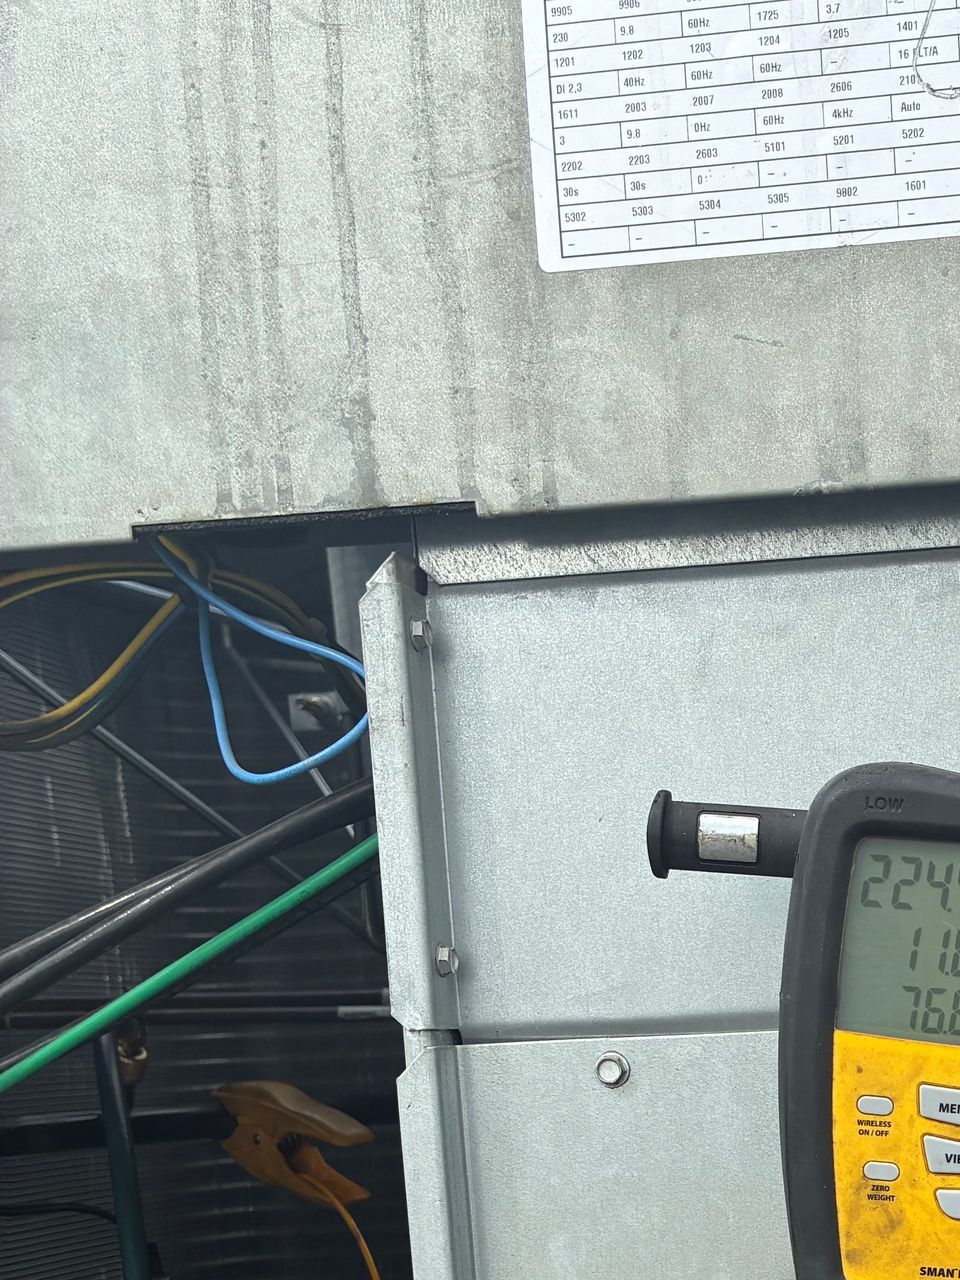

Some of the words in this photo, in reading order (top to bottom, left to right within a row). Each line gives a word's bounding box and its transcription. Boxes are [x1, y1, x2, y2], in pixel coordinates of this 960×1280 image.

[551, 6, 573, 17] 9905
[552, 33, 569, 43] 230
[620, 25, 634, 36] 9.8
[688, 18, 710, 29] 60Hz
[758, 10, 779, 21] 1725
[826, 4, 840, 14] 3.7
[554, 57, 575, 68] 1201
[622, 50, 643, 61] 1202
[690, 43, 712, 54] 1203
[759, 36, 780, 46] 1204
[828, 28, 850, 39] 1205
[897, 21, 918, 32] 1401
[624, 77, 645, 88] 40Hz
[691, 70, 712, 81] 60Hz
[760, 62, 782, 73] 60Hz
[558, 109, 578, 120] 1611
[625, 102, 647, 114] 2003
[693, 95, 714, 106] 2007
[762, 88, 784, 99] 2008
[830, 81, 852, 92] 2606
[763, 115, 784, 126] 60Hz
[832, 108, 854, 119] 4kHz
[901, 102, 921, 112] Auto
[562, 161, 583, 172] 2202
[628, 154, 650, 166] 2203
[696, 148, 718, 160] 2603
[764, 142, 786, 152] 5101
[833, 135, 854, 146] 5201
[902, 128, 924, 140] 5202
[563, 187, 579, 198] 30s
[630, 181, 646, 192] 30s
[565, 212, 586, 223] 5302
[632, 206, 654, 217] 5303
[699, 200, 721, 211] 5304
[768, 192, 790, 204] 5305
[836, 186, 858, 198] 9802
[905, 180, 927, 192] 1601
[865, 796, 904, 813] LOW
[857, 1119, 892, 1128] WIRELESS
[876, 1130, 890, 1138] OFF
[867, 1194, 896, 1202] WEIGHT
[871, 1184, 890, 1192] ZERO
